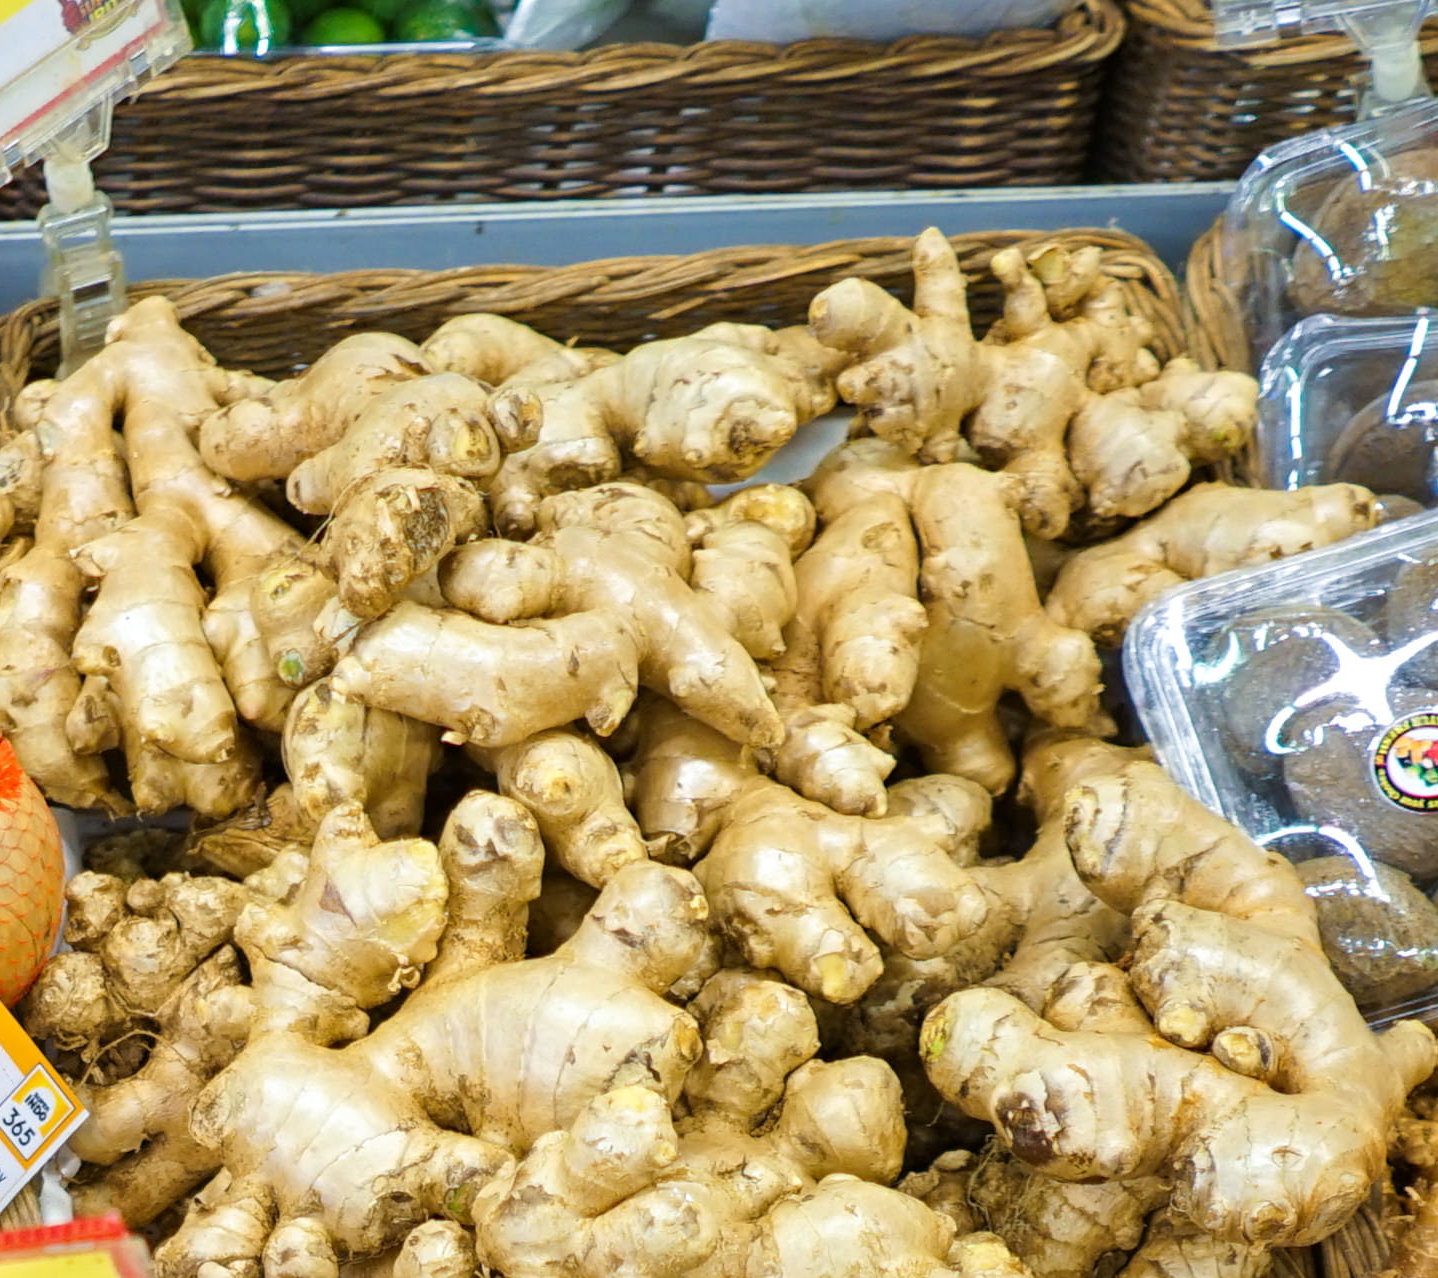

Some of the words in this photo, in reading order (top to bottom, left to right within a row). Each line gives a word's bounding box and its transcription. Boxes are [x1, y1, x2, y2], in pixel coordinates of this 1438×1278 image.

[24, 1094, 47, 1121] INDO
[33, 1091, 50, 1112] SUPER
[2, 1108, 35, 1146] 365
